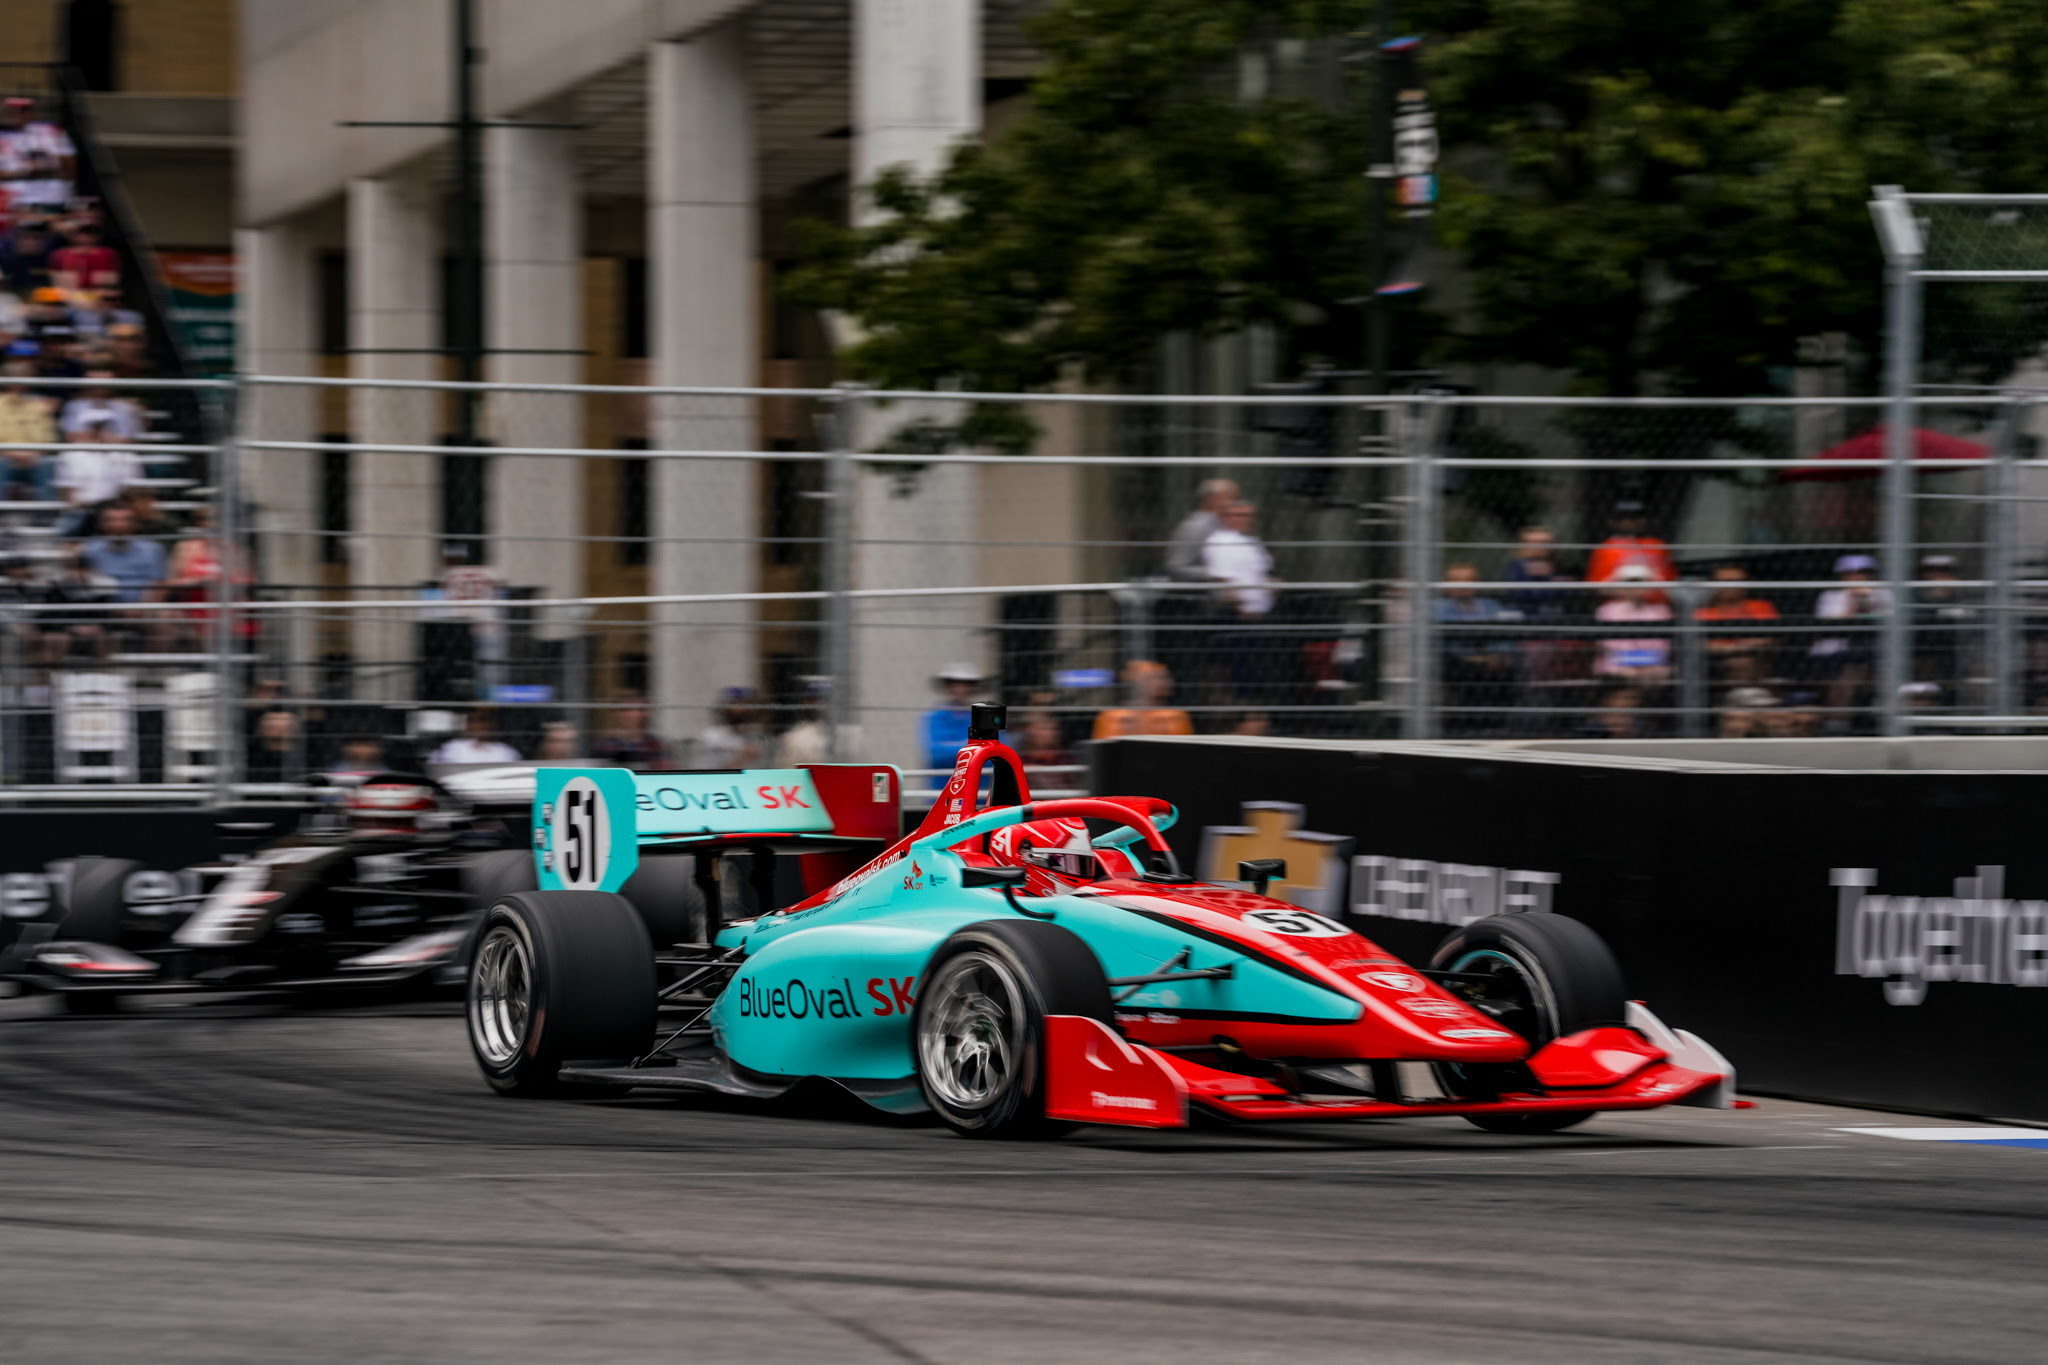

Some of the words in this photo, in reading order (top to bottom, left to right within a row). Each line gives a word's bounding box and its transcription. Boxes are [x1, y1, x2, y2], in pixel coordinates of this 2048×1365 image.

[757, 785, 812, 809] SK
[564, 790, 598, 883] 51
[903, 876, 915, 890] SK
[1250, 912, 1345, 933] 51
[740, 976, 862, 1019] BlueOval
[866, 976, 916, 1017] SK
